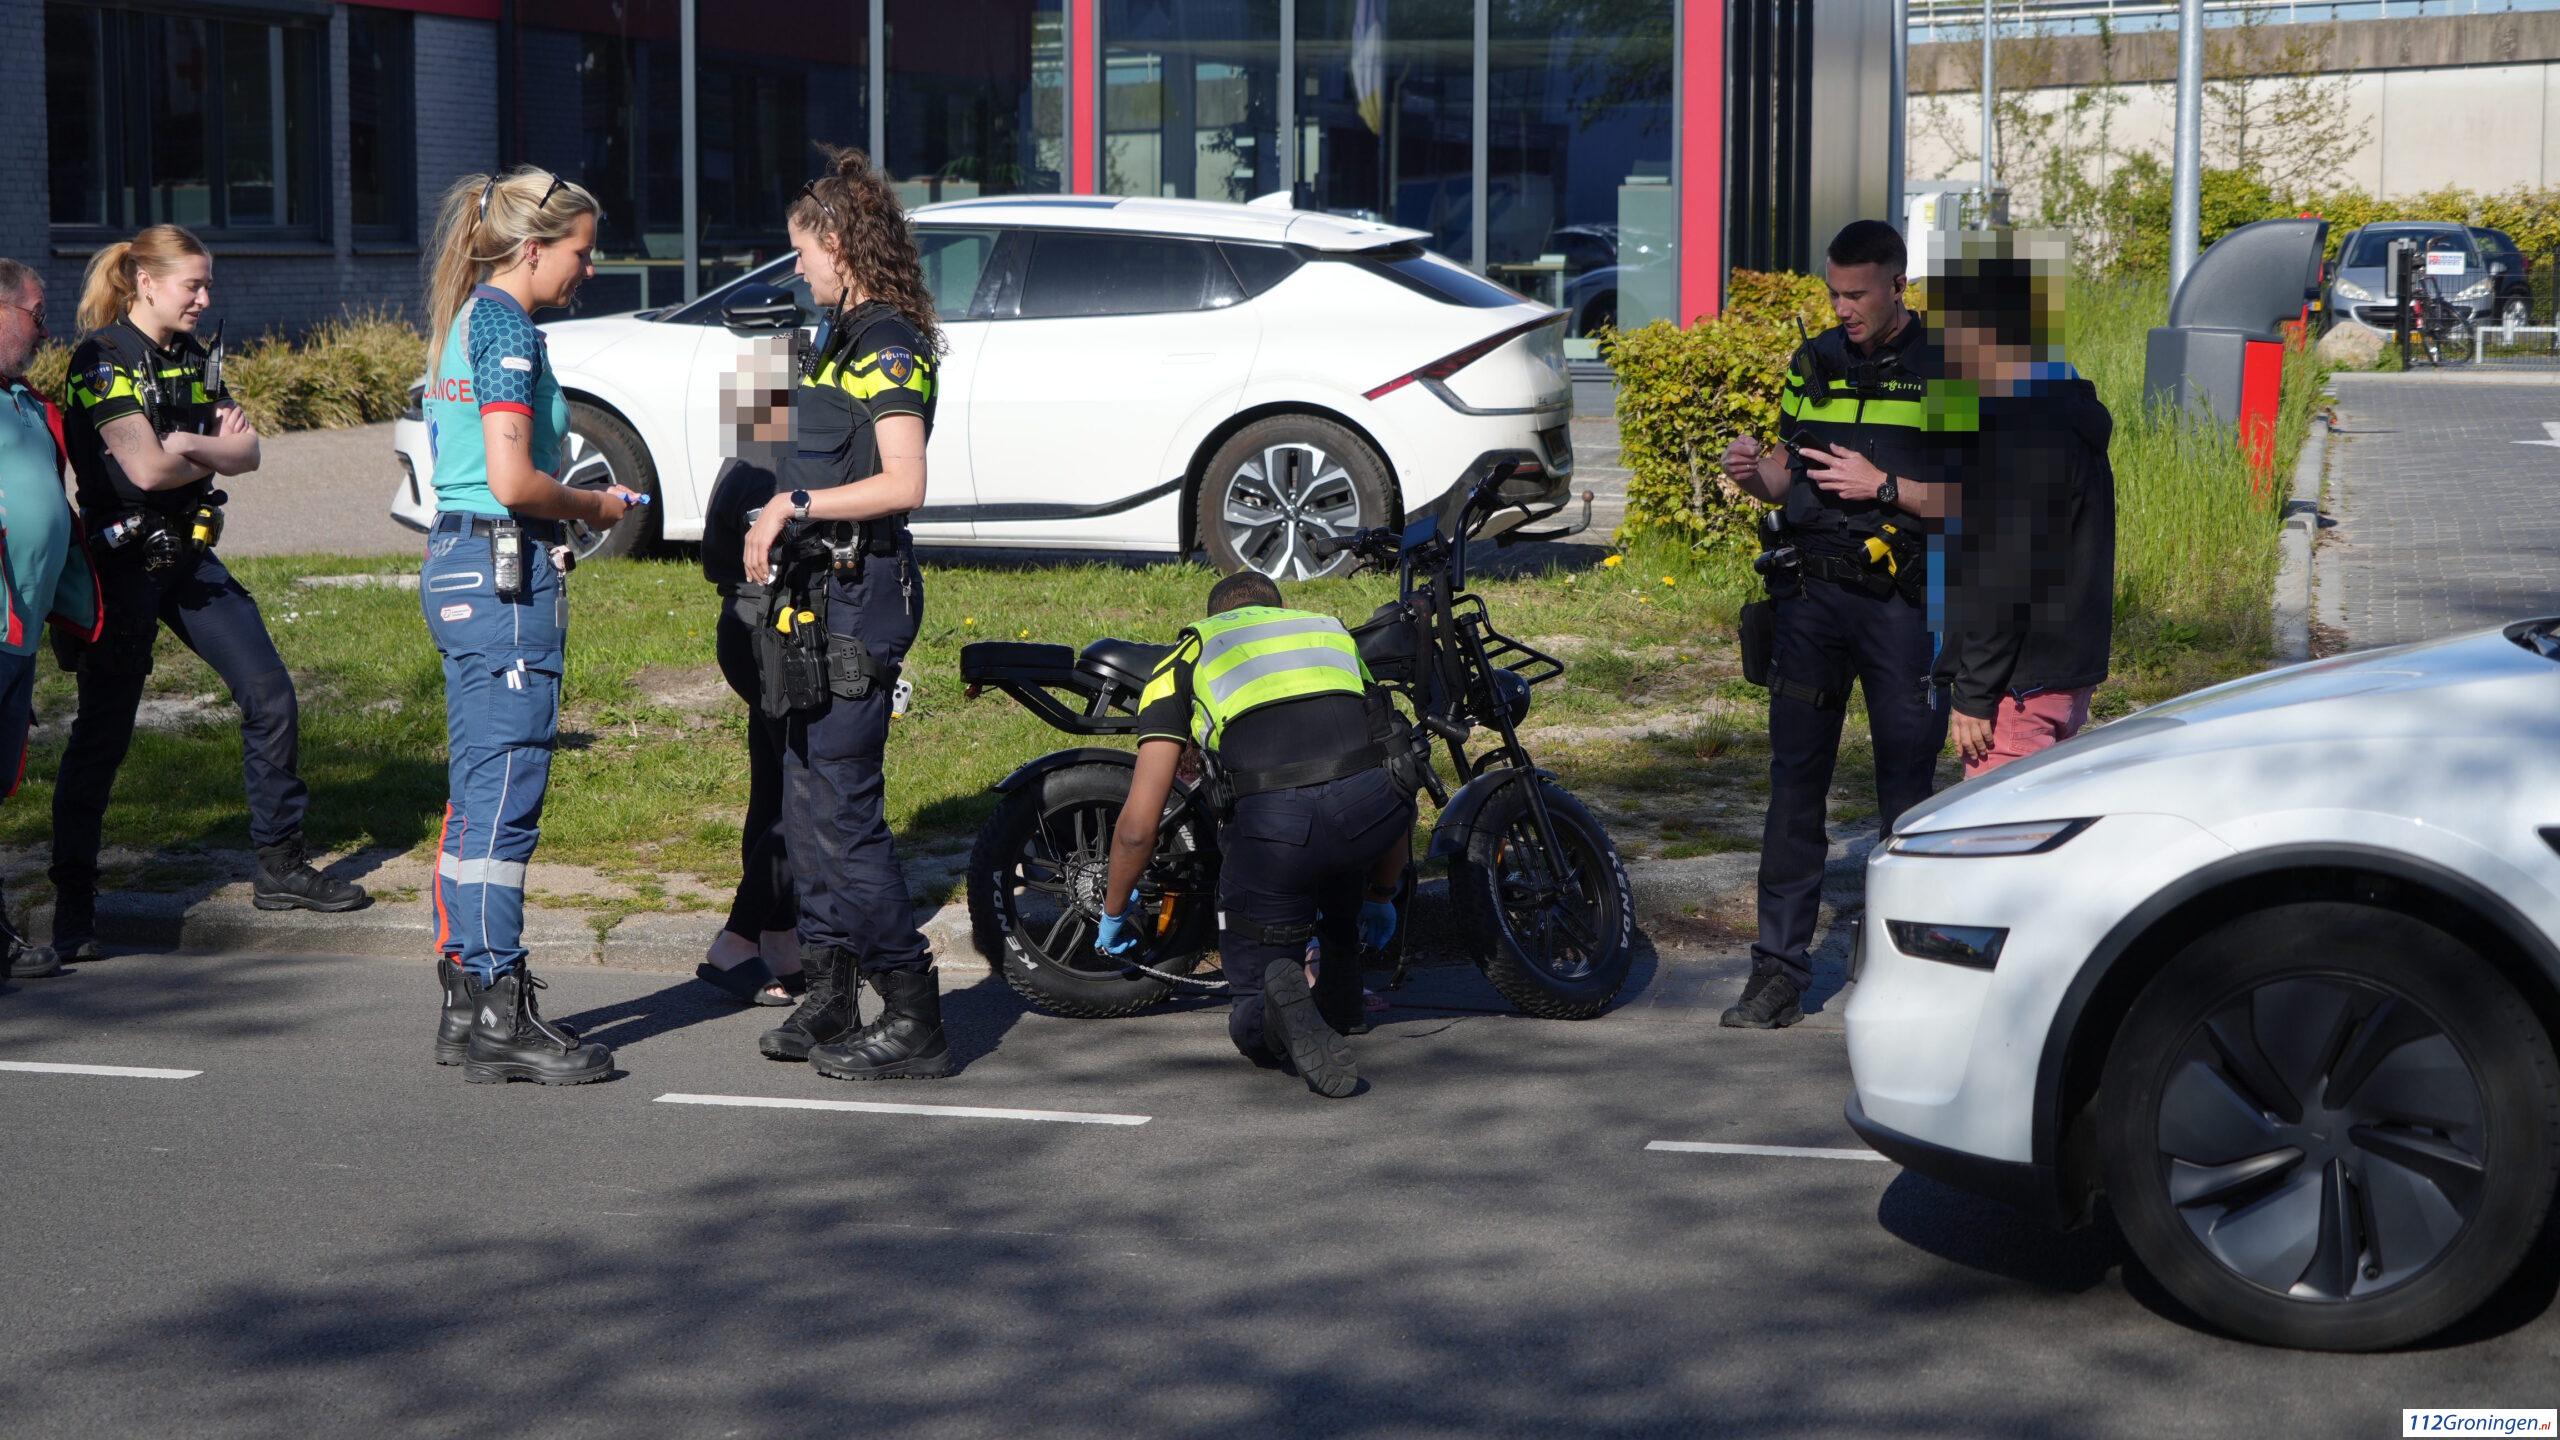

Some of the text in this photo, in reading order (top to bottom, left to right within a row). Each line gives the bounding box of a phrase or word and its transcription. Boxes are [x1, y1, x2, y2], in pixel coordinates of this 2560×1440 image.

[881, 350, 910, 360] POLITIE
[992, 870, 1039, 971] KENDA
[1607, 851, 1631, 950] KENDA
